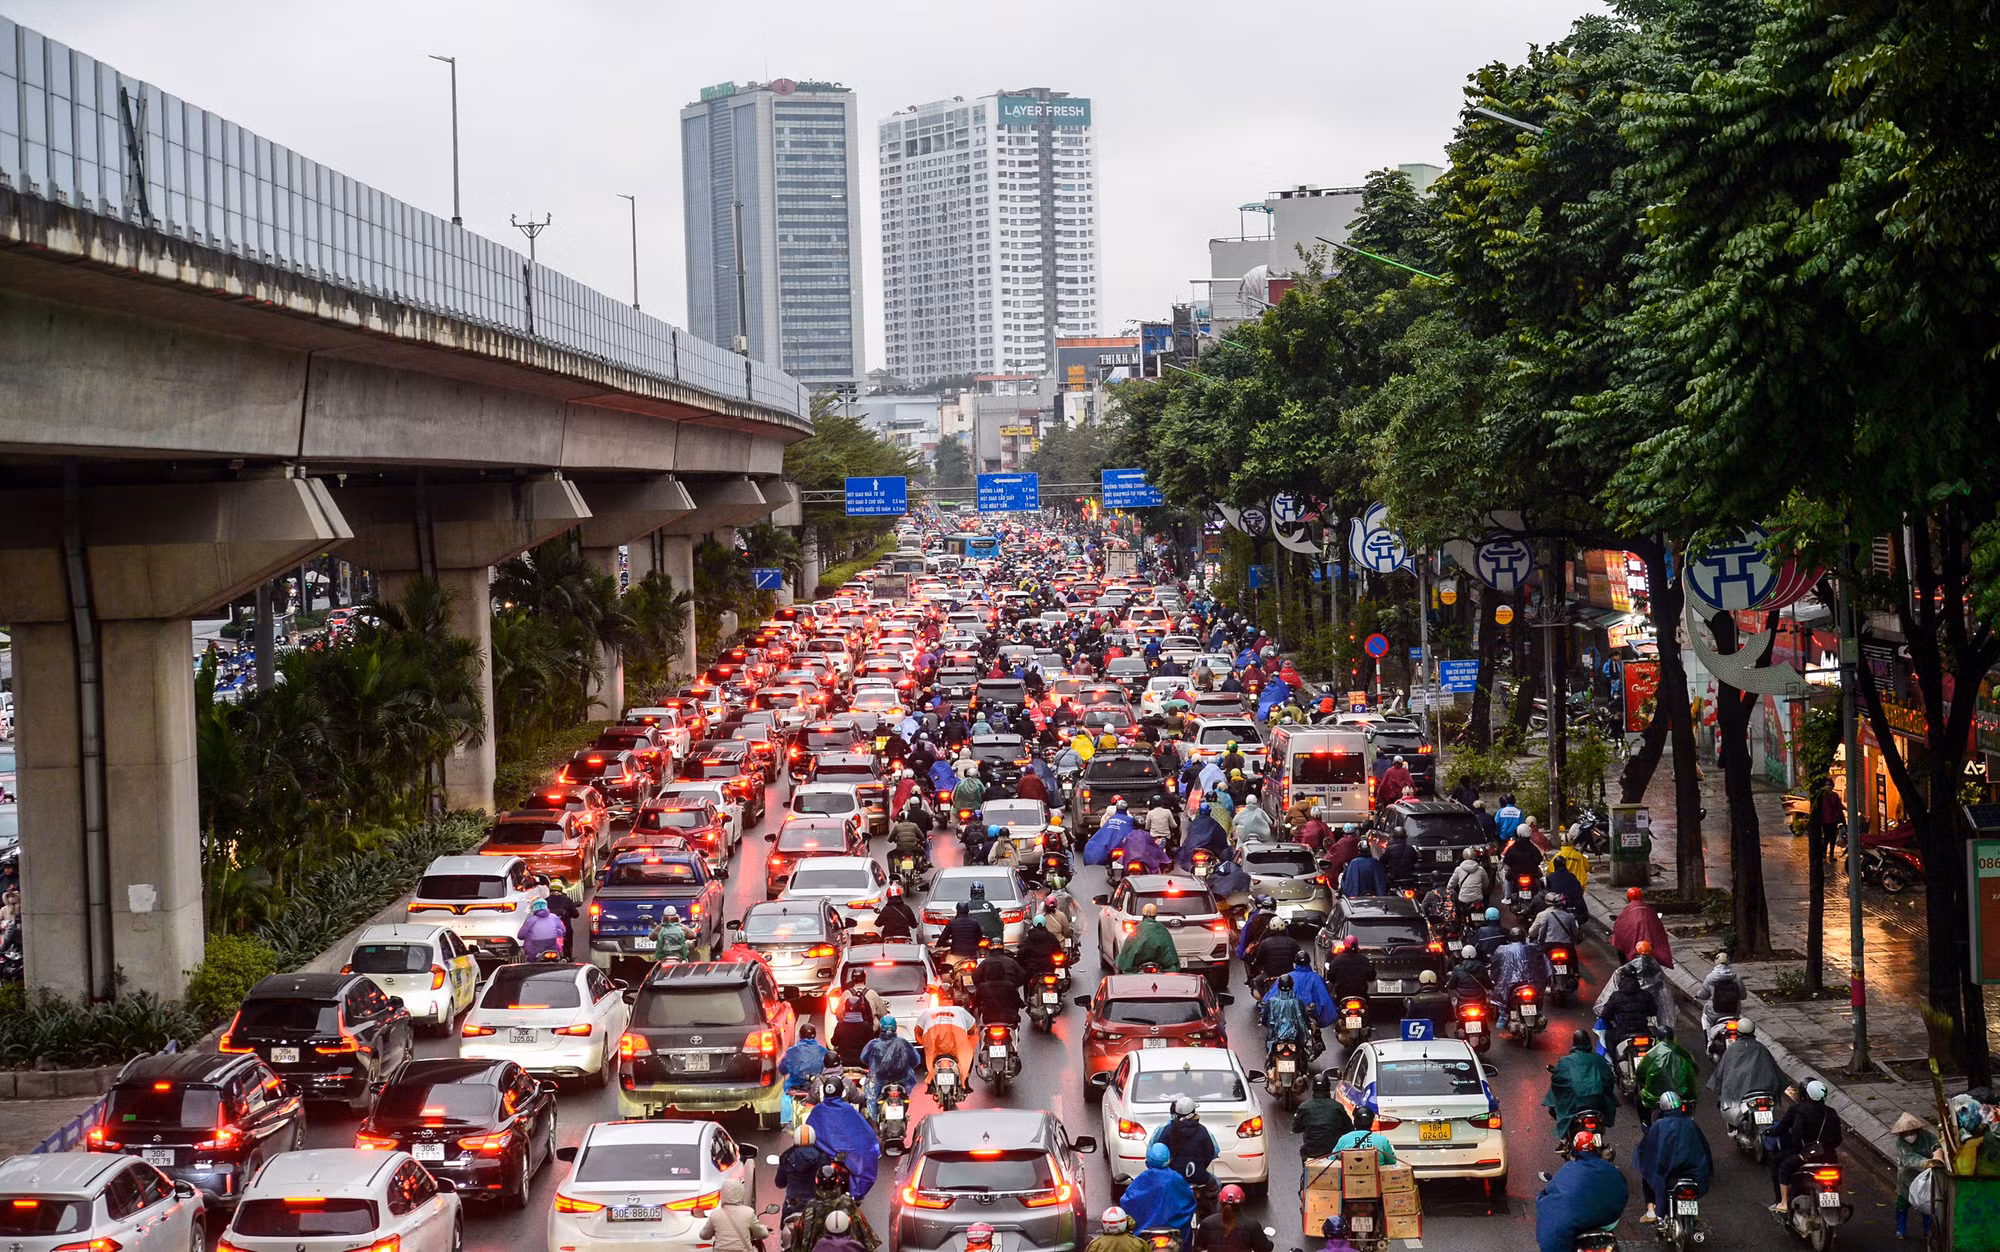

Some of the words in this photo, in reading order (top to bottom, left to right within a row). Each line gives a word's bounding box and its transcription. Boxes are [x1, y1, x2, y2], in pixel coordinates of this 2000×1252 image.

[1005, 105, 1042, 117] LAYER
[1046, 106, 1084, 116] FRESH
[1099, 353, 1128, 366] THỊNH
[1409, 1022, 1426, 1038] G7
[1148, 1039, 1161, 1047] 30G
[1422, 1131, 1448, 1139] 024.04
[421, 1144, 435, 1152] 30G
[613, 1207, 662, 1219] 30E-886.05
